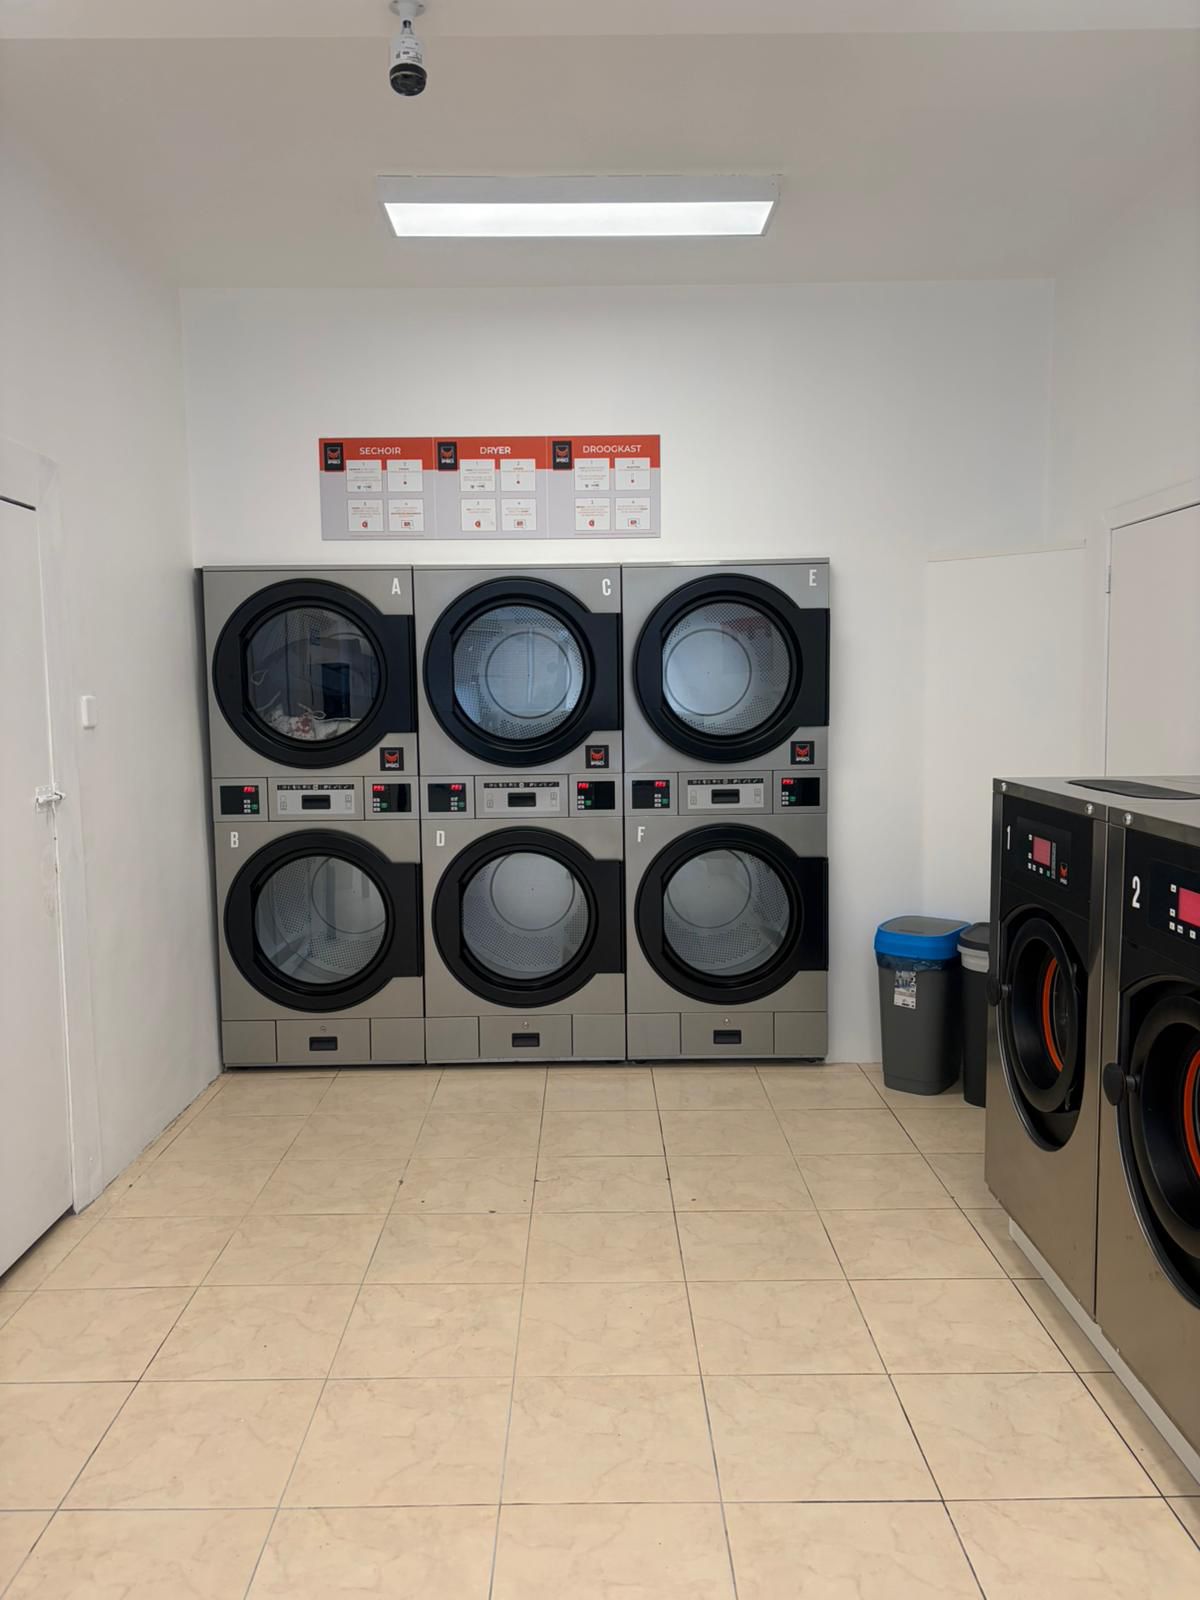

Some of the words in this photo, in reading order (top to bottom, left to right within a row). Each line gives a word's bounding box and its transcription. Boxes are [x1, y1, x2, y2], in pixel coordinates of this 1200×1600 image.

[359, 446, 401, 455] SECHOIR
[479, 446, 512, 455] DRYER
[582, 445, 642, 454] DROOGKAST
[391, 577, 401, 595] A
[808, 570, 817, 587] E
[602, 579, 611, 596] C
[230, 831, 239, 848] B
[436, 831, 445, 847] D
[637, 826, 646, 843] F
[1006, 825, 1011, 851] 1
[1131, 876, 1141, 909] 2
